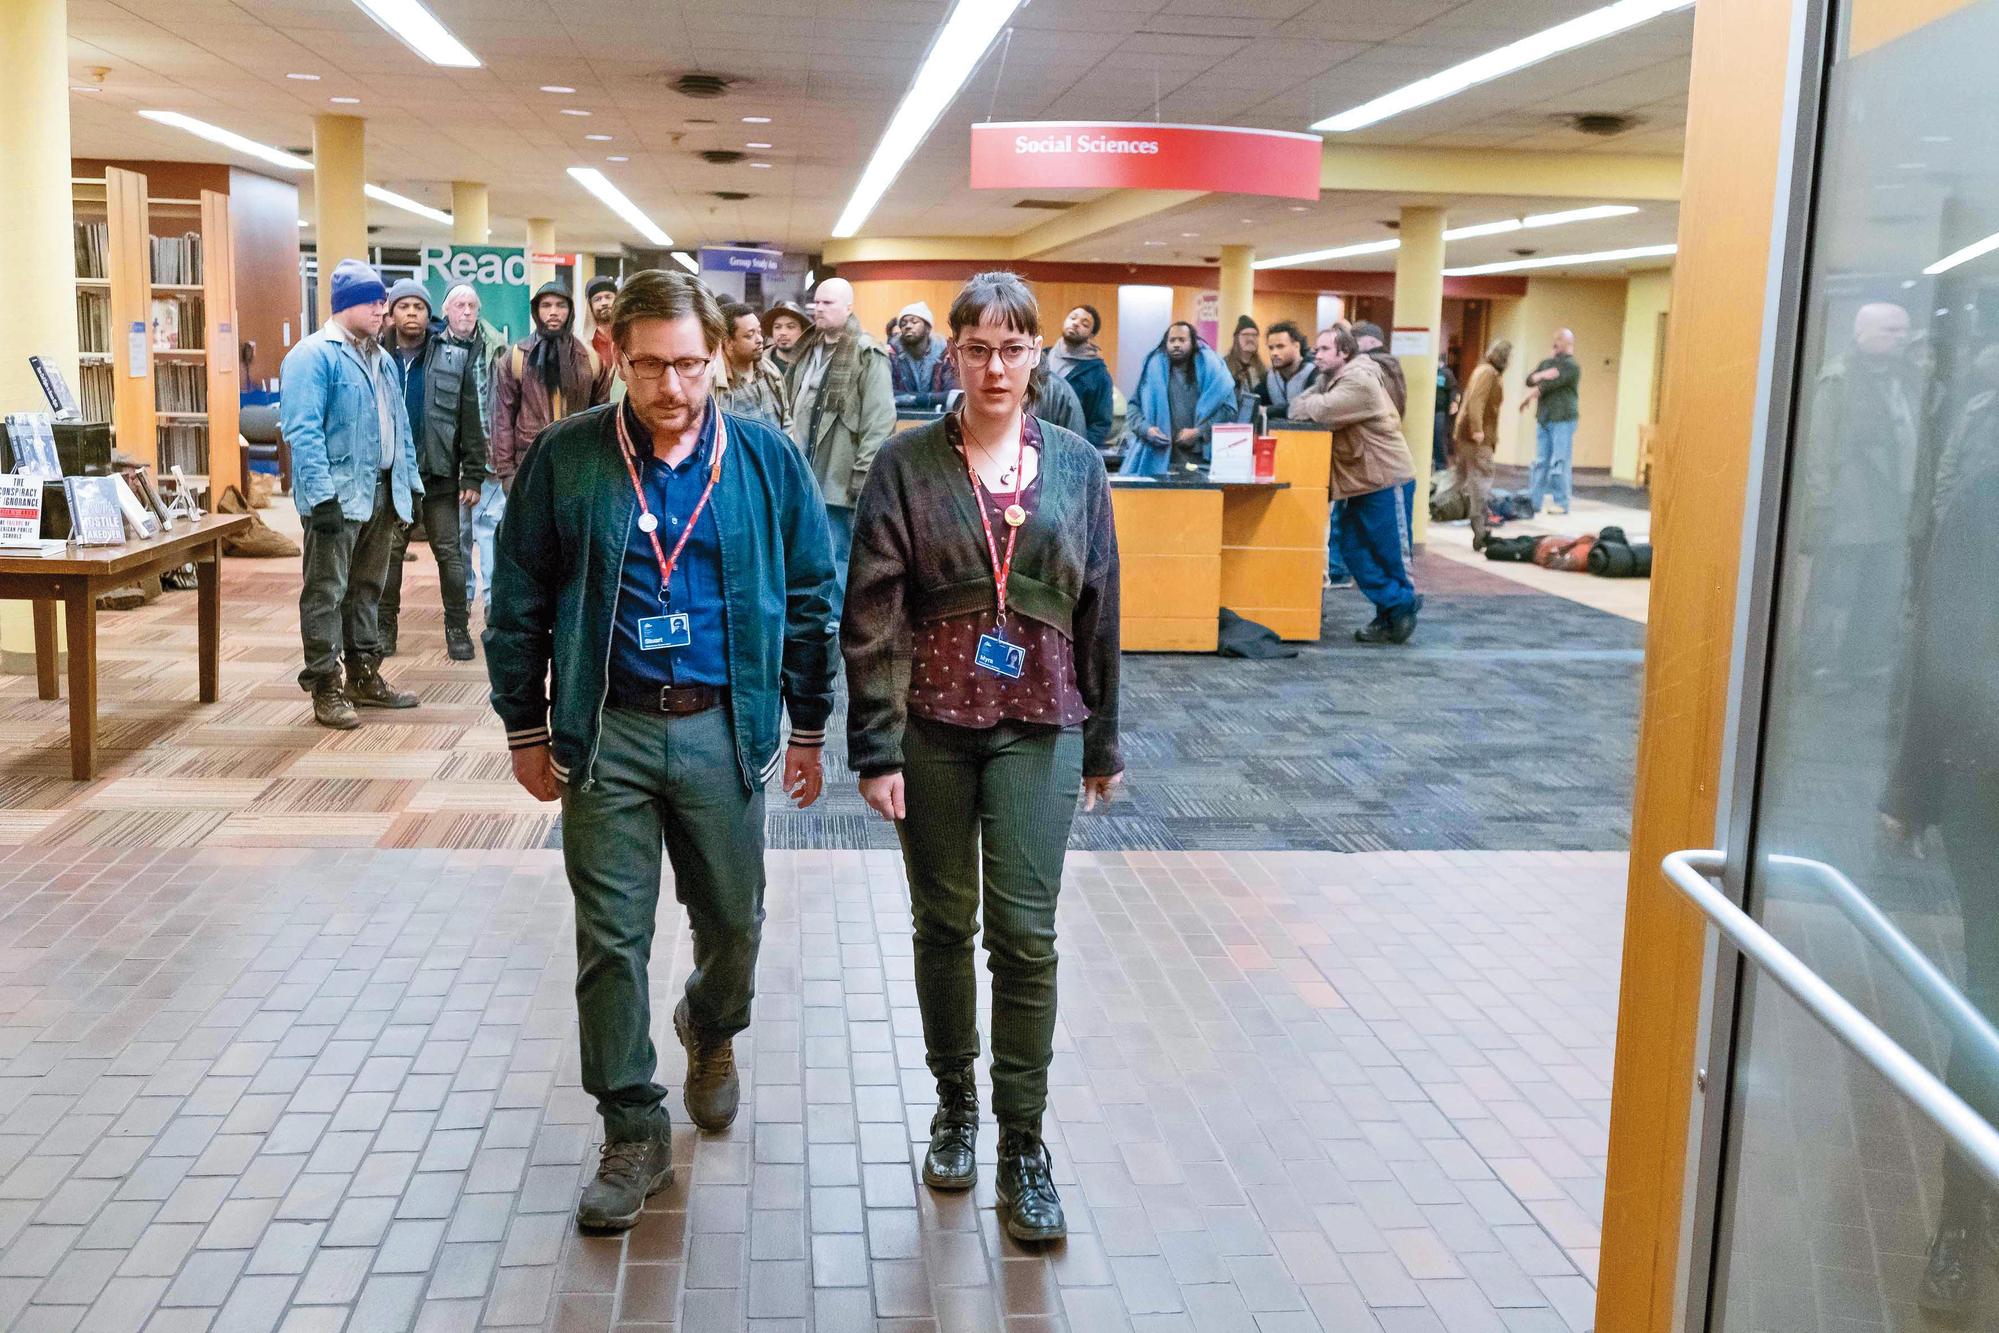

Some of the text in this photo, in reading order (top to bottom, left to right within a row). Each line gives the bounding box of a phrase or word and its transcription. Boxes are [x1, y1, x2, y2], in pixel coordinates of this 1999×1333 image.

[1015, 135, 1159, 154] Social Sciences
[420, 245, 531, 286] Read
[729, 256, 752, 269] Group
[752, 257, 768, 271] Study
[13, 477, 24, 486] THE
[3, 496, 39, 507] IGNORANCE
[81, 516, 120, 527] HOSTILE
[83, 529, 122, 540] TAKEOVER
[980, 654, 994, 664] Myra
